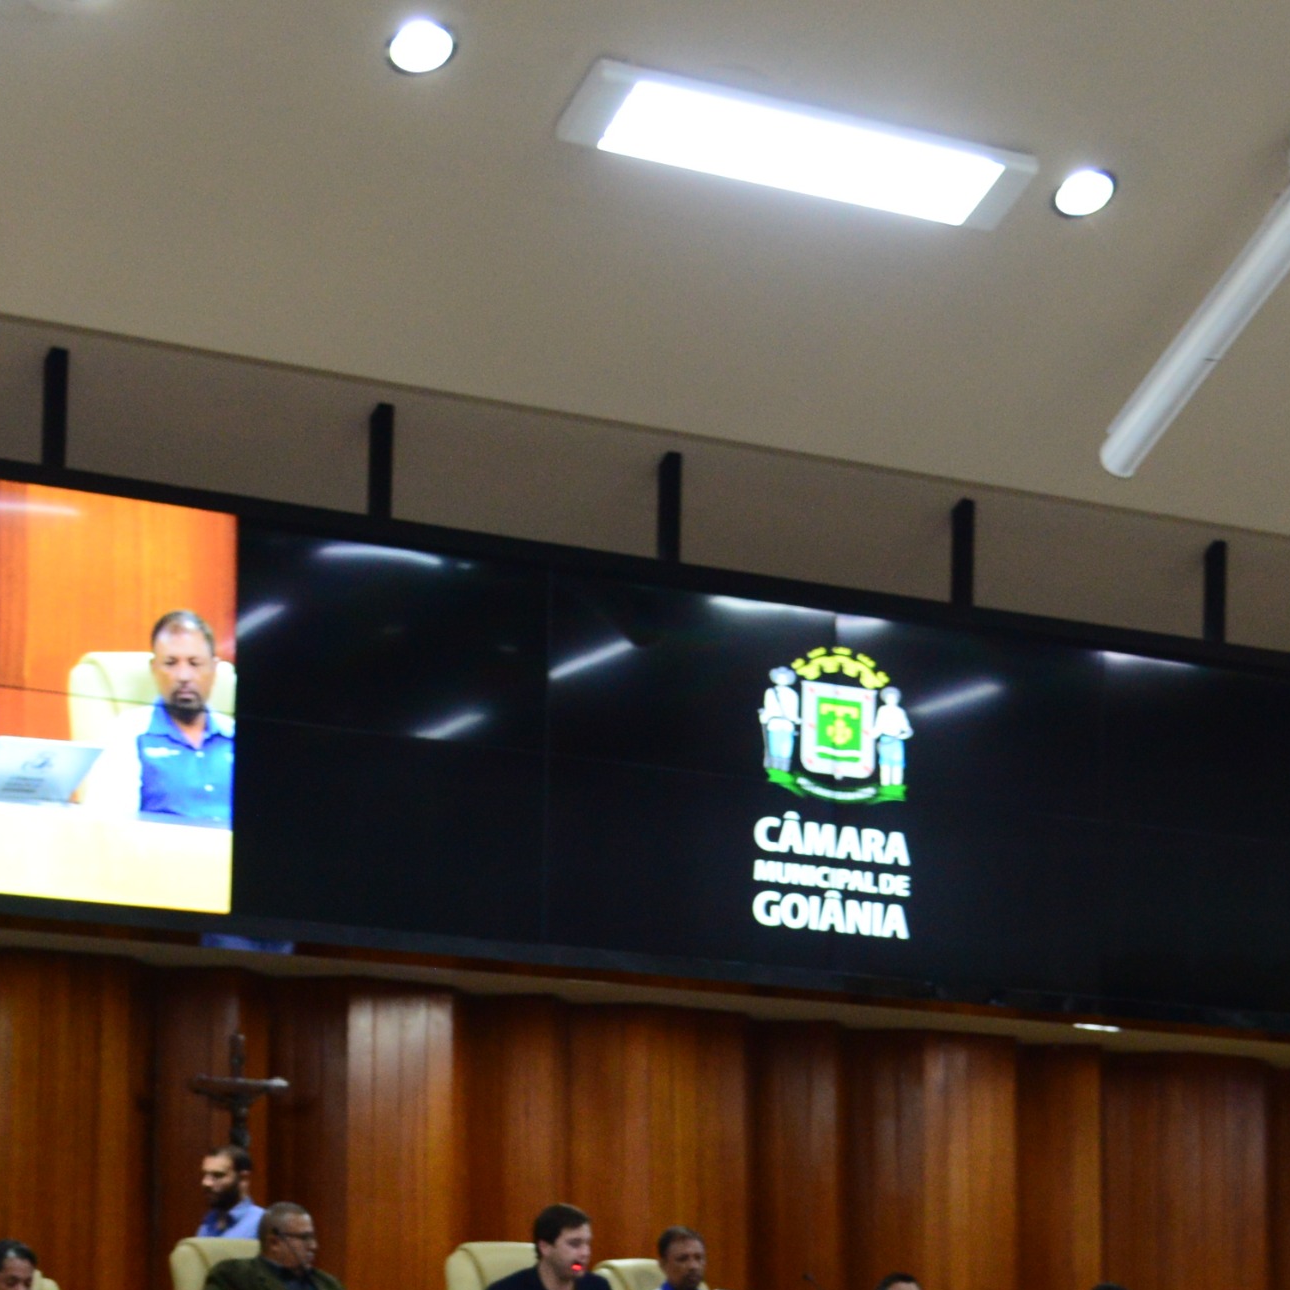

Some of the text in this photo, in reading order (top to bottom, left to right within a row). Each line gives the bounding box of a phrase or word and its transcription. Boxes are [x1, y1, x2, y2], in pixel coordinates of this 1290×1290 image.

[753, 811, 911, 866] CÂMARA
[753, 859, 911, 897] MUNICIPAL DE
[752, 890, 910, 940] GOIÂNIA
